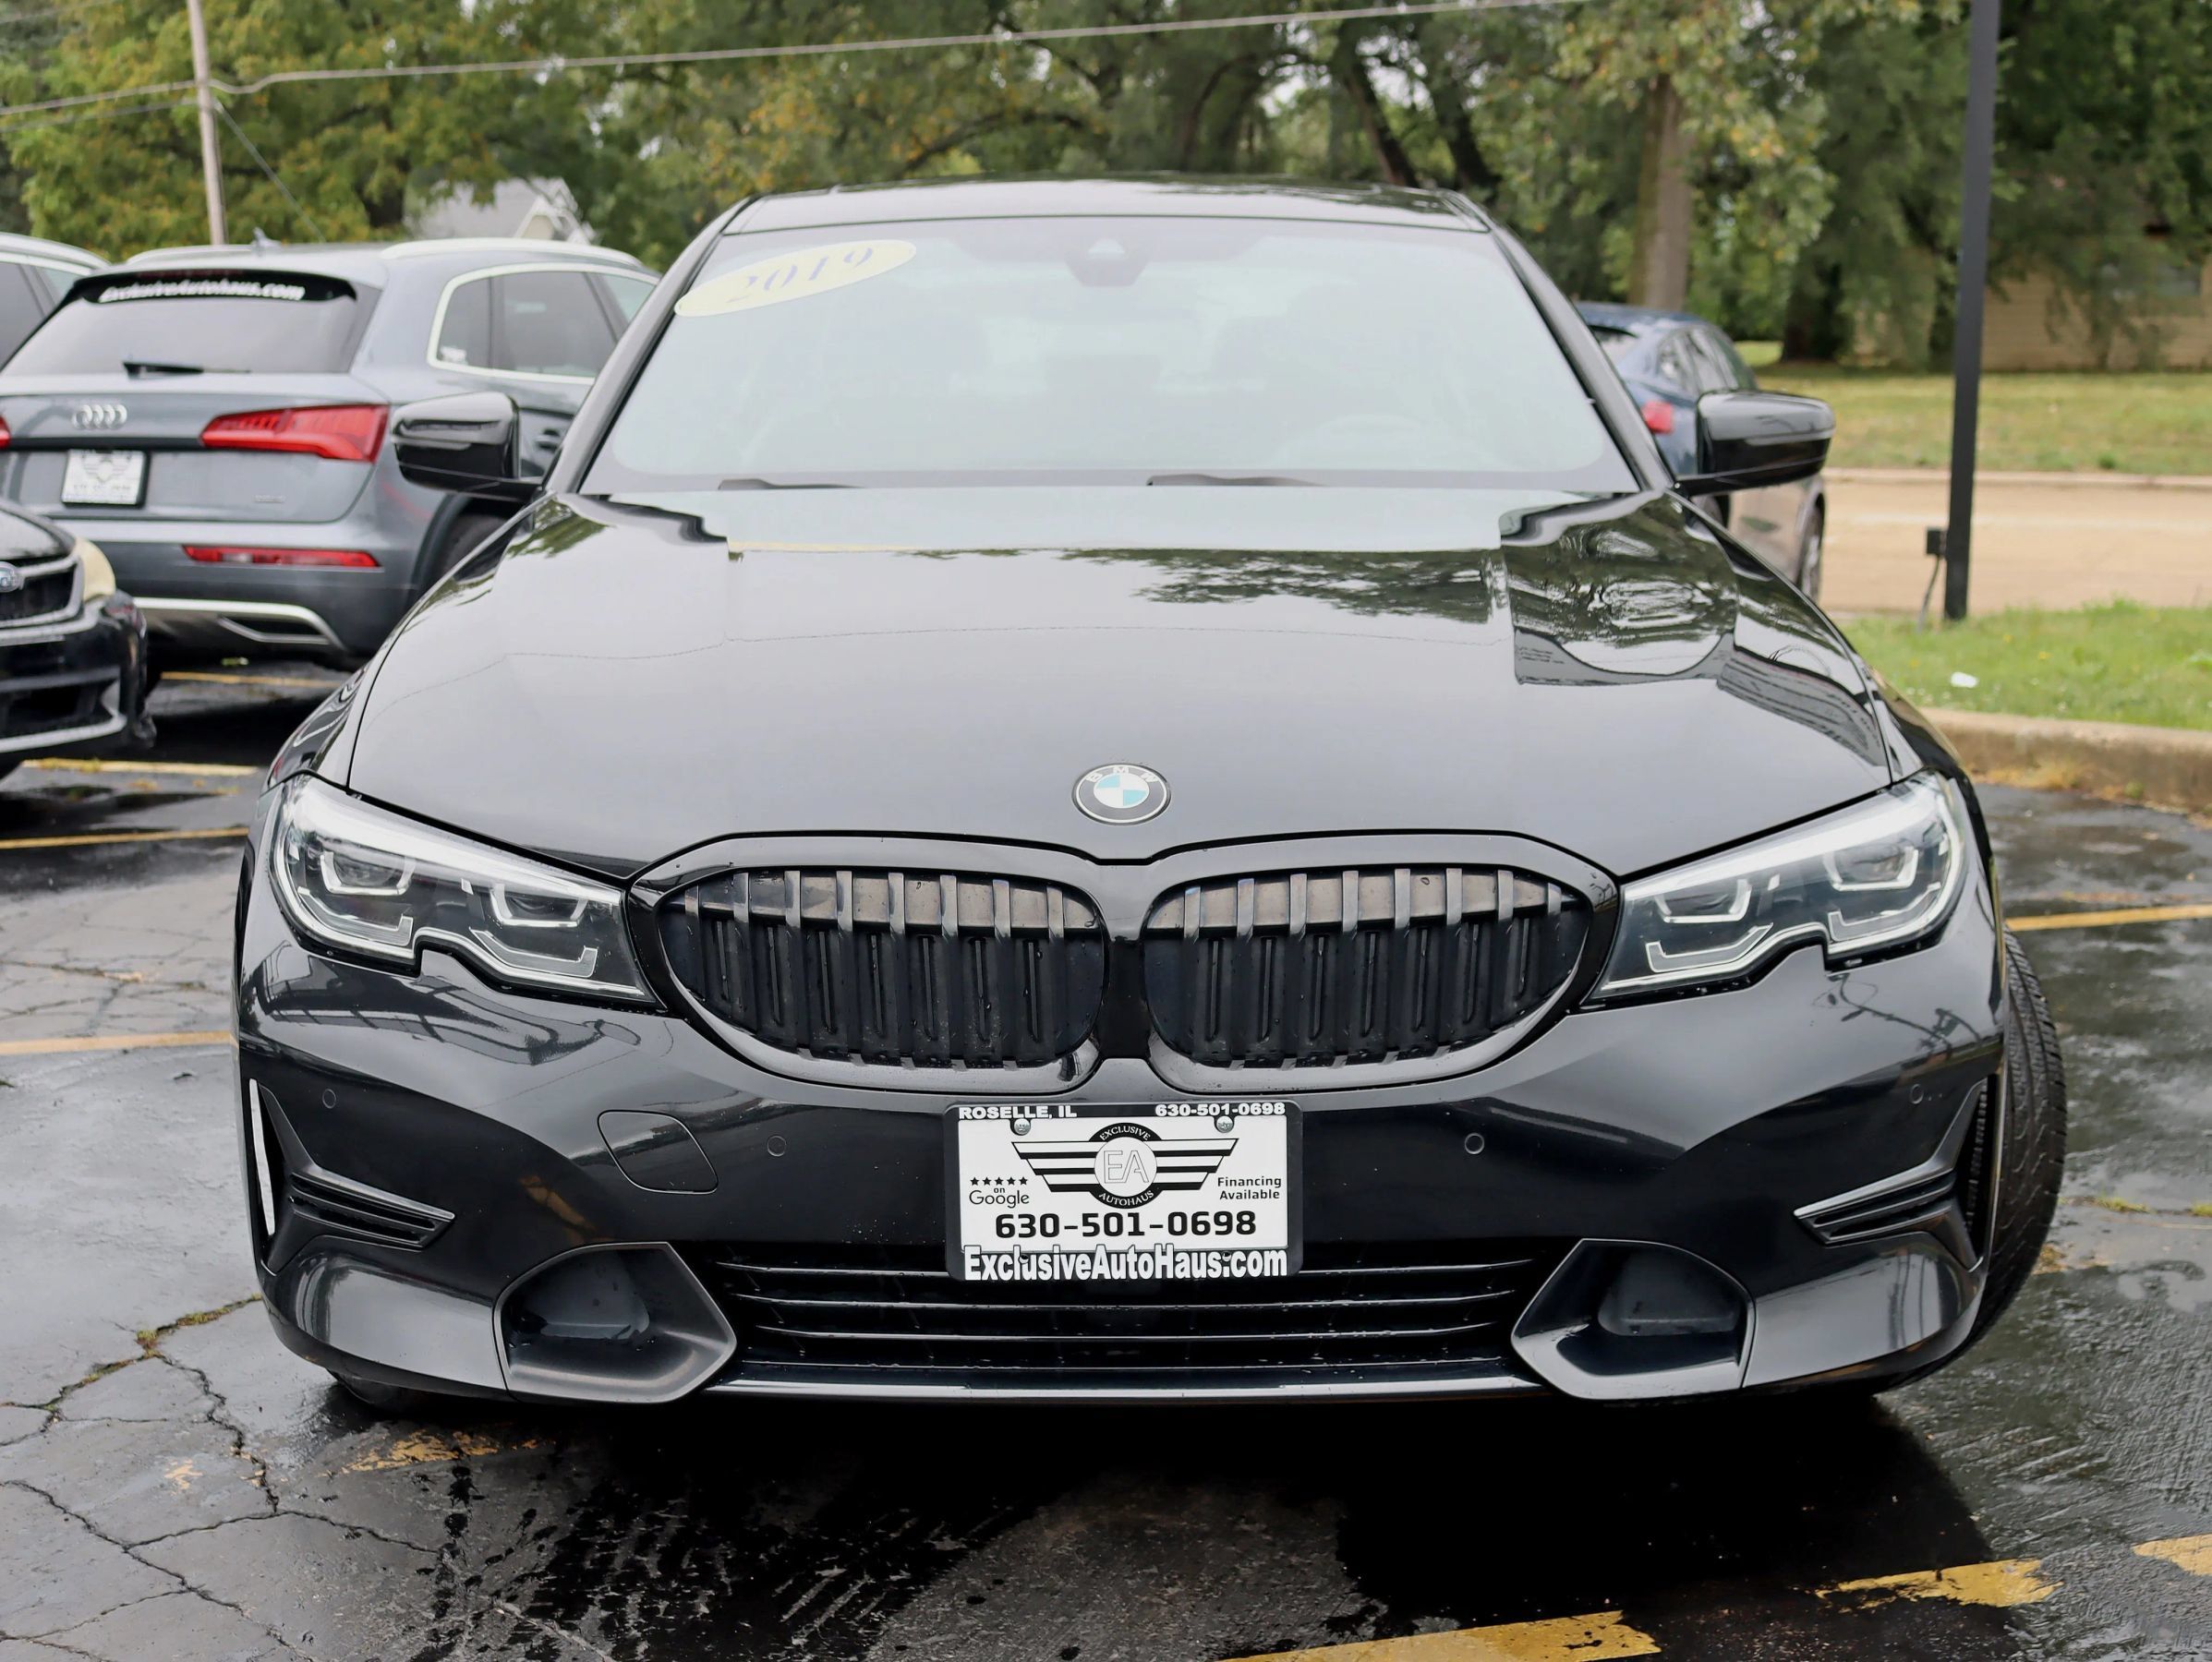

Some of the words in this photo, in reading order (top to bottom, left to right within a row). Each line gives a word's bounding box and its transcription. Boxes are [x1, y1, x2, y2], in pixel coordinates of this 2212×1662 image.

[724, 247, 874, 304] 2019
[1085, 765, 1160, 783] BMW
[959, 1105, 1054, 1119] ROSELLE,
[1058, 1104, 1078, 1118] IL
[1154, 1102, 1287, 1117] 630-501-0698
[1099, 1125, 1152, 1141] EXCLUSIVE
[1104, 1150, 1150, 1184] EA
[1217, 1176, 1283, 1189] Financing
[969, 1189, 1030, 1209] Google
[1098, 1190, 1154, 1206] AUTOHAUS
[1219, 1188, 1281, 1200] Available
[995, 1210, 1257, 1238] 630-501-0698
[963, 1243, 1287, 1282] ExclusiveAutoHaus.com
